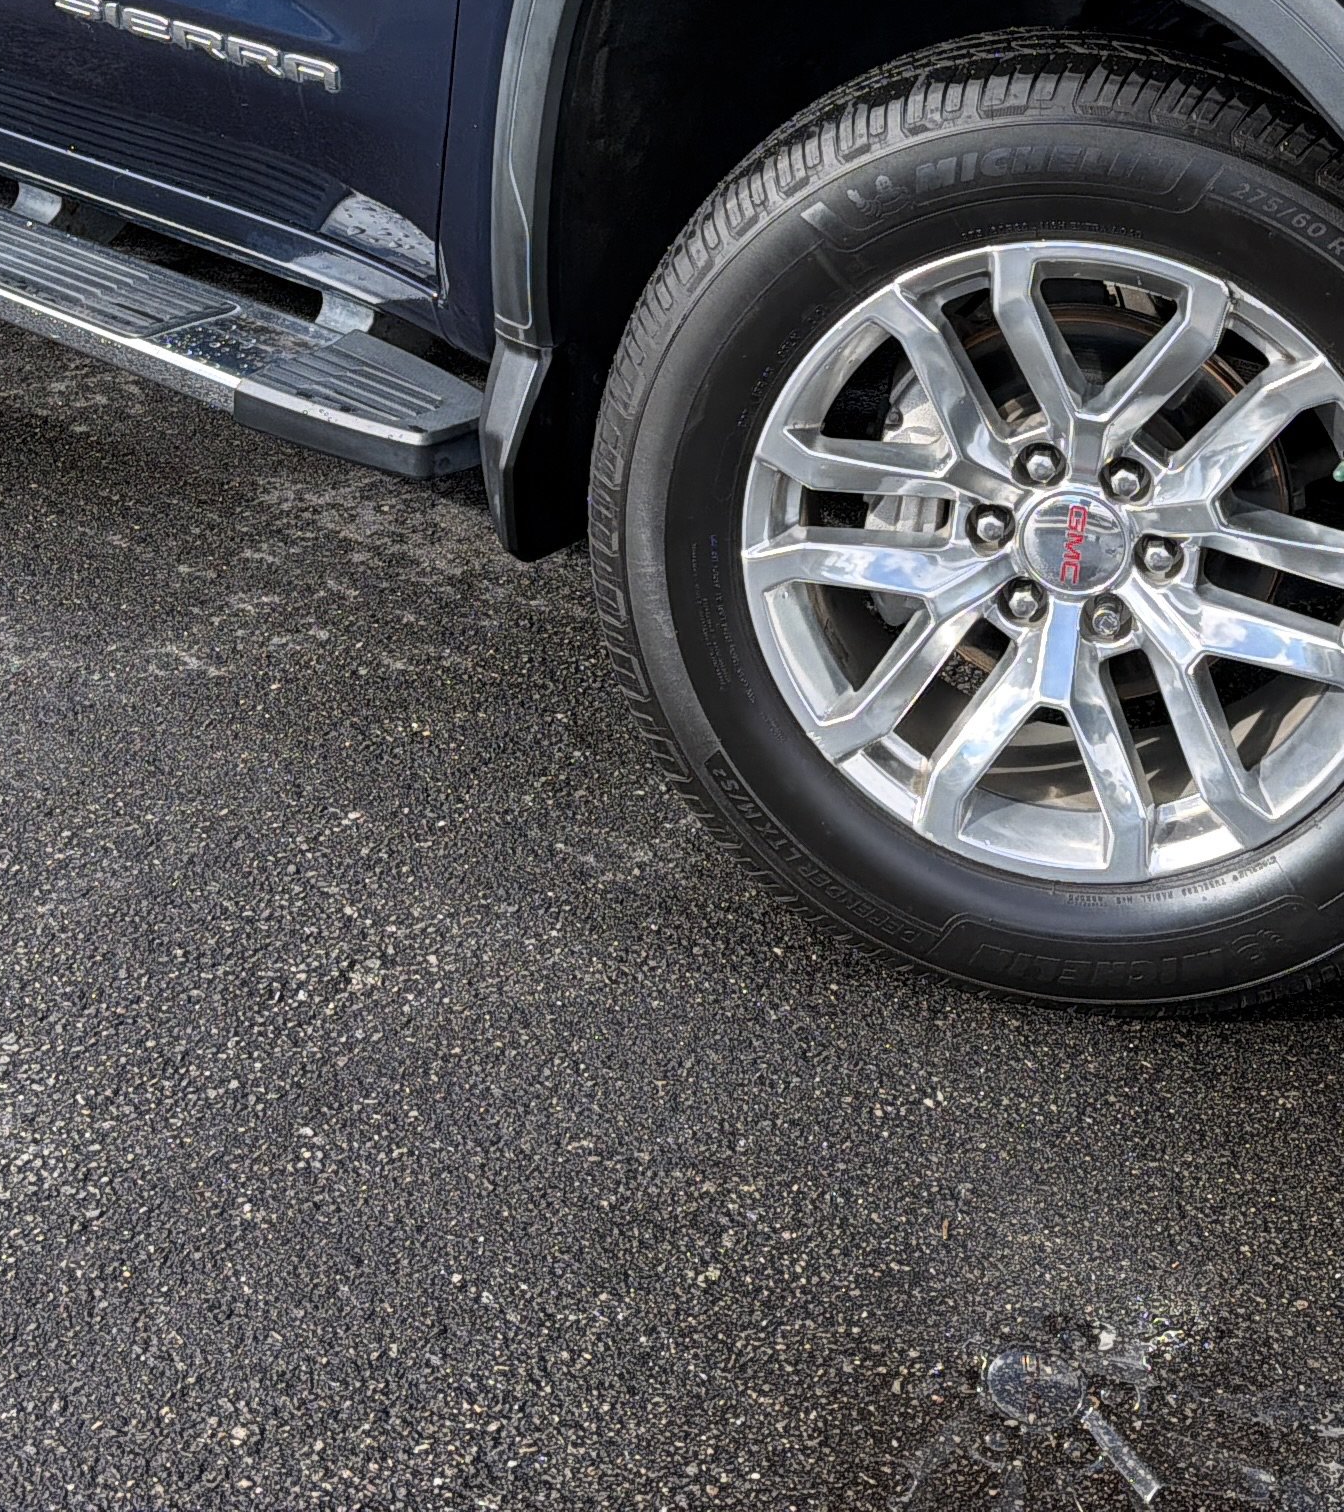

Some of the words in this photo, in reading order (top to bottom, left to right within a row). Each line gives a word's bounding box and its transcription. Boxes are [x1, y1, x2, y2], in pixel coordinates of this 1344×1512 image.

[914, 144, 1184, 194] MICHELIN
[1230, 181, 1328, 239] 275/60
[1059, 504, 1088, 585] GMC
[756, 820, 803, 862] LTX
[798, 864, 921, 944] DEFENDER
